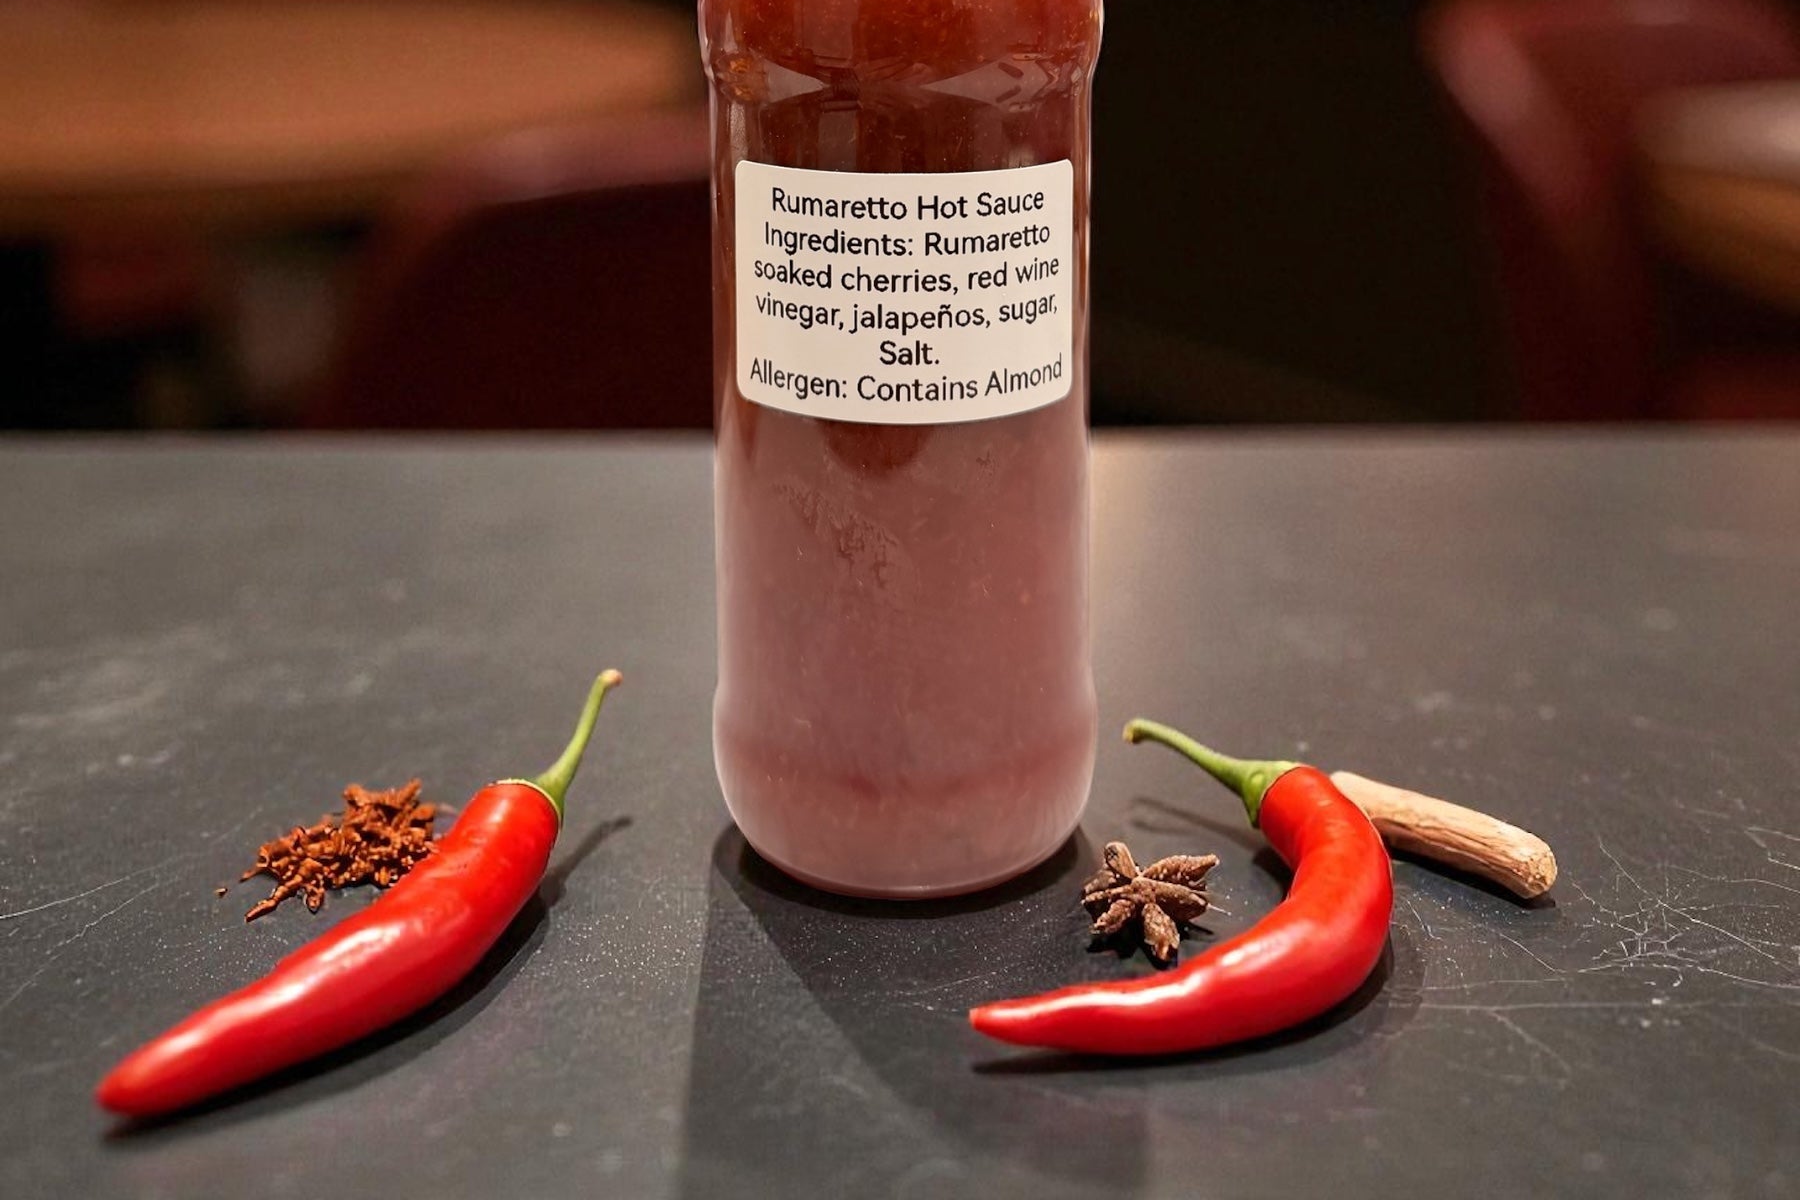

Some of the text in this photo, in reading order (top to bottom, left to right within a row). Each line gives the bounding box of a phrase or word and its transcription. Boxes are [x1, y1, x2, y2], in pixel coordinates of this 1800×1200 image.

[771, 187, 1044, 220] Rumaretto Hot Sauce
[765, 221, 1050, 256] Ingredients: Rumaretto
[754, 257, 1059, 295] soaked cherries, red wine
[755, 292, 1058, 335] vinegar, jalapeños, sugar,
[879, 340, 940, 366] Salt.
[750, 353, 1062, 402] Allergen: Contains Almond
